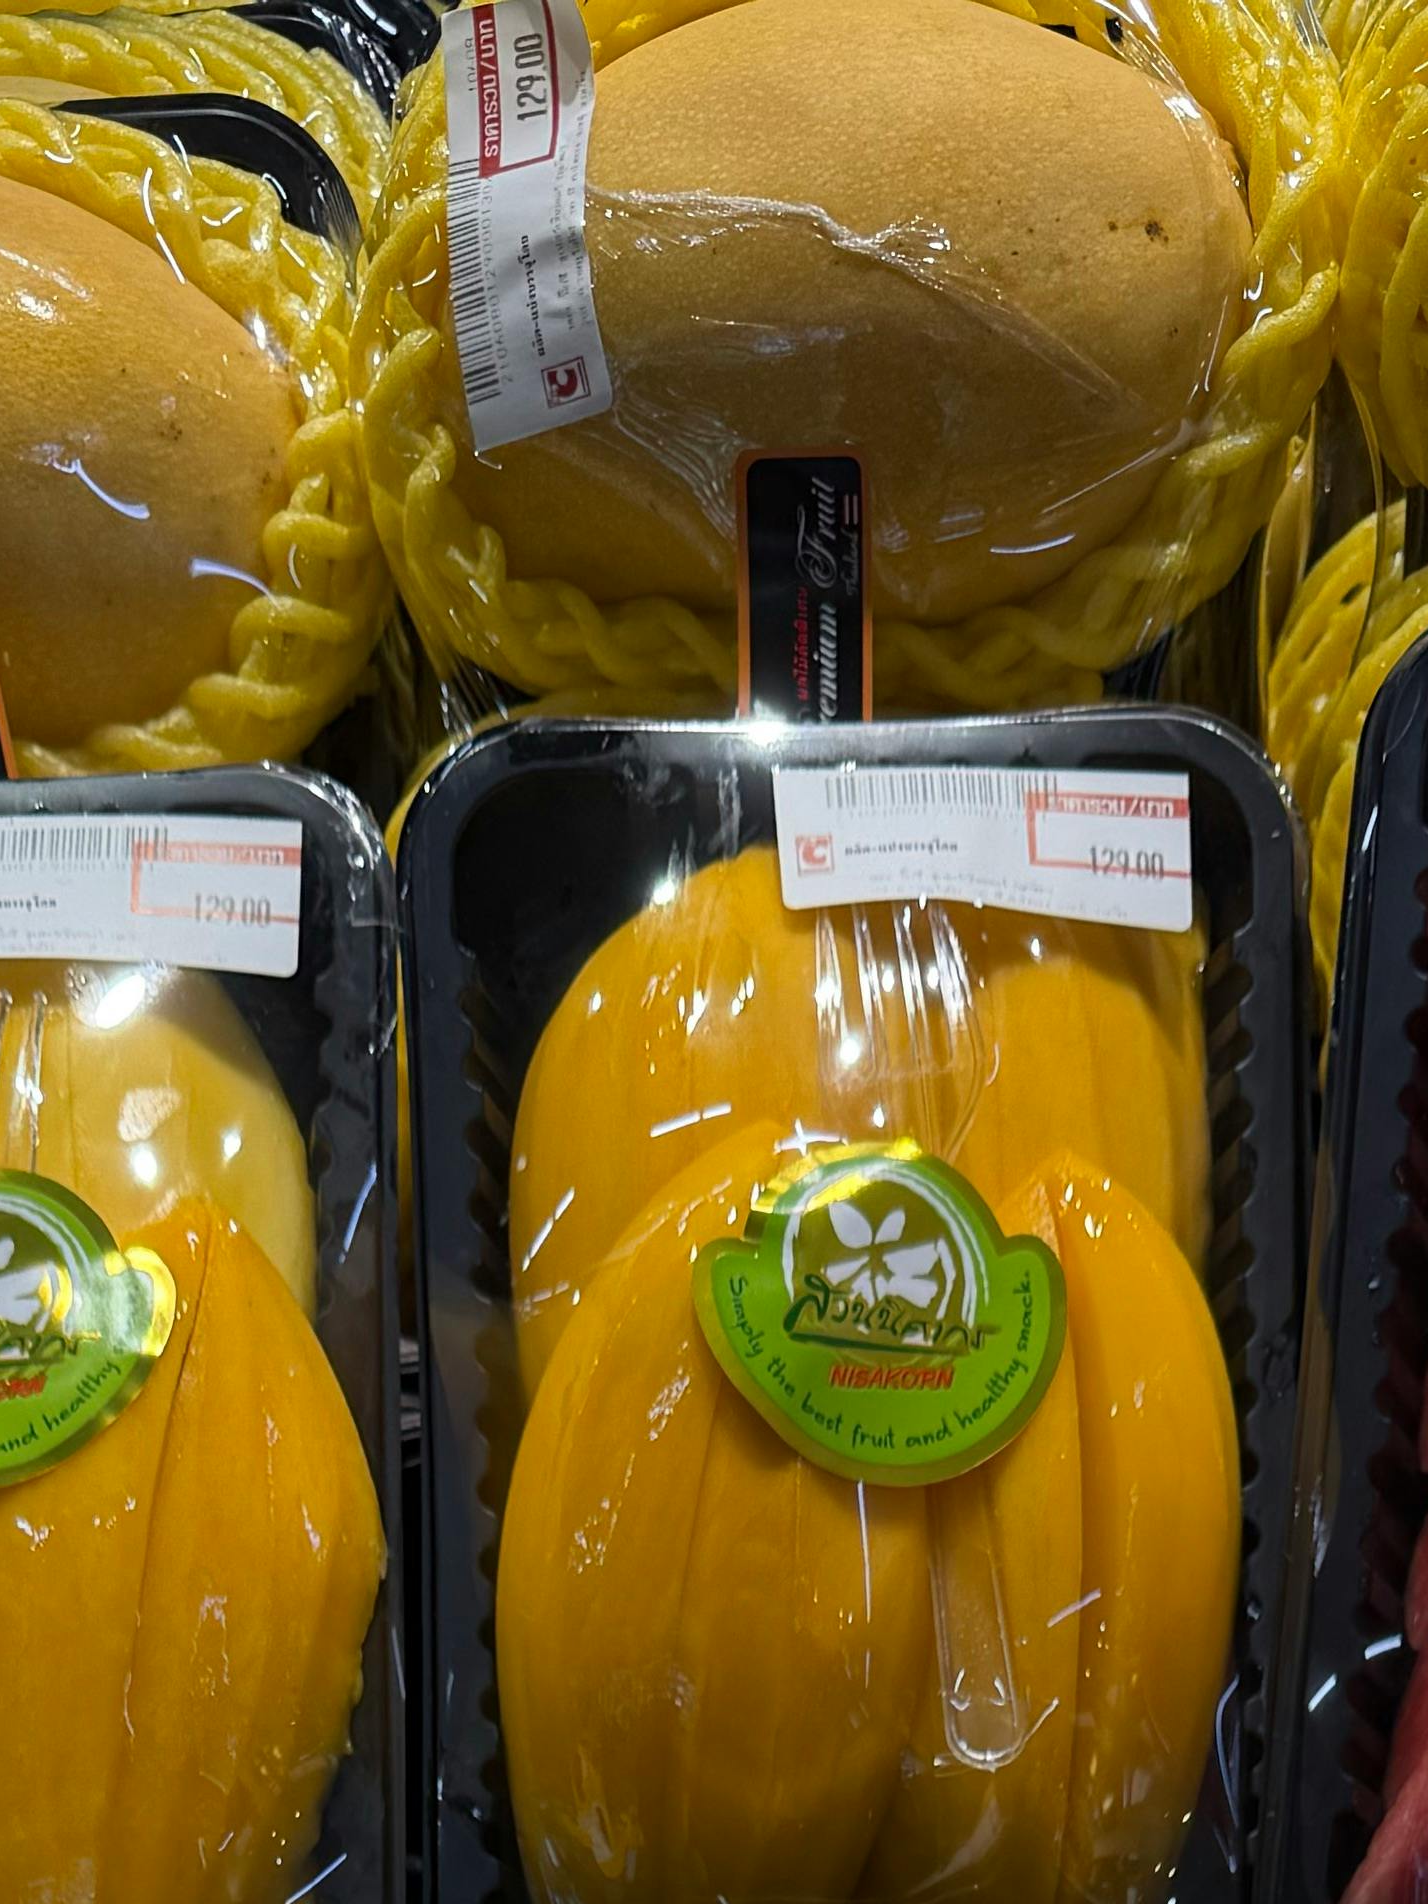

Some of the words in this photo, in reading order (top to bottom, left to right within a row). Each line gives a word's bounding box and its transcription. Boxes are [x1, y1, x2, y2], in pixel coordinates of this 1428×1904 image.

[478, 20, 499, 158] ราคารวม/บาท
[513, 32, 548, 120] 129.00
[795, 477, 836, 588] Fruit
[1089, 844, 1165, 880] 129.00
[194, 893, 272, 928] 129.00
[43, 1361, 120, 1430] healthy
[728, 1277, 764, 1356] Simply
[768, 1357, 794, 1397] the
[801, 1397, 844, 1435] best
[851, 1426, 895, 1448] fruit
[906, 1419, 954, 1446] and
[955, 1359, 1027, 1428] healthy
[1014, 1273, 1033, 1351] snack.
[829, 1366, 953, 1389] NISAKORN
